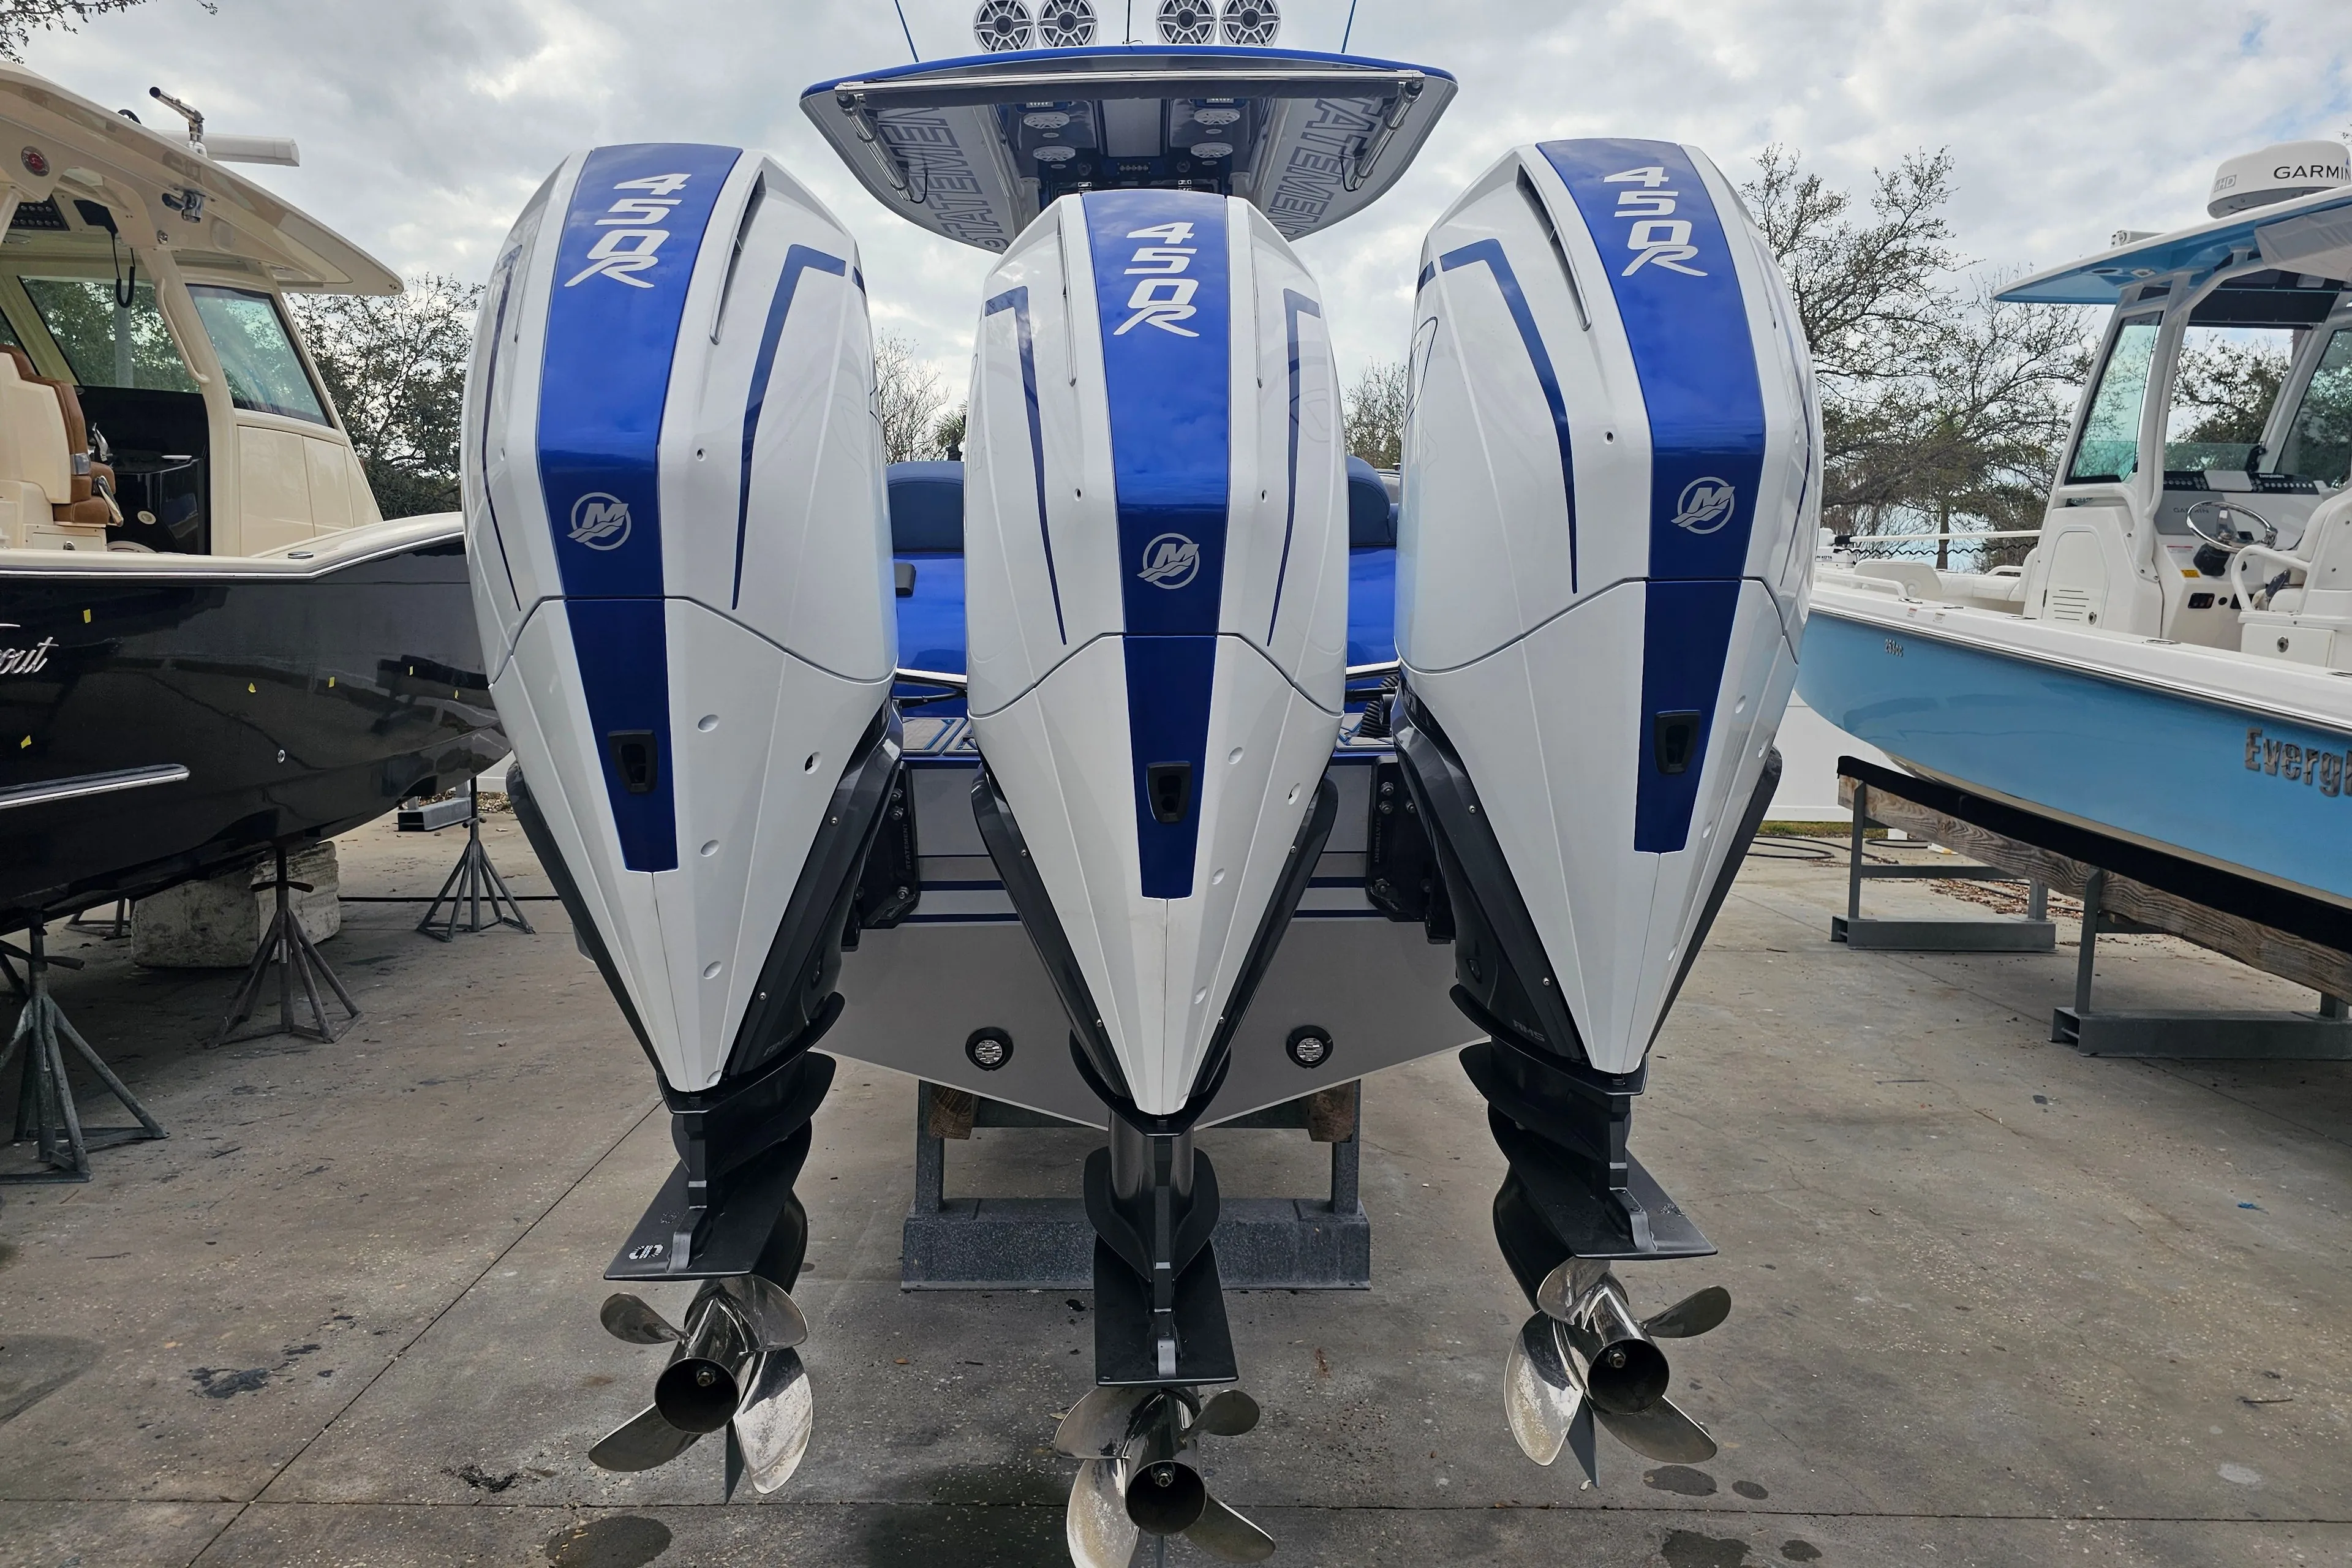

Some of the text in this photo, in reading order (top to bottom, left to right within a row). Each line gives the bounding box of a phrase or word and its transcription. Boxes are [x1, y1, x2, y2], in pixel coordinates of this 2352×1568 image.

[878, 107, 1009, 250] STATEMEN
[1268, 98, 1381, 237] TATEMEN
[1603, 167, 1708, 276] 450R
[2273, 165, 2351, 180] GARMIN
[564, 173, 692, 288] 450R
[1113, 222, 1200, 337] 450R
[0, 636, 59, 674] out
